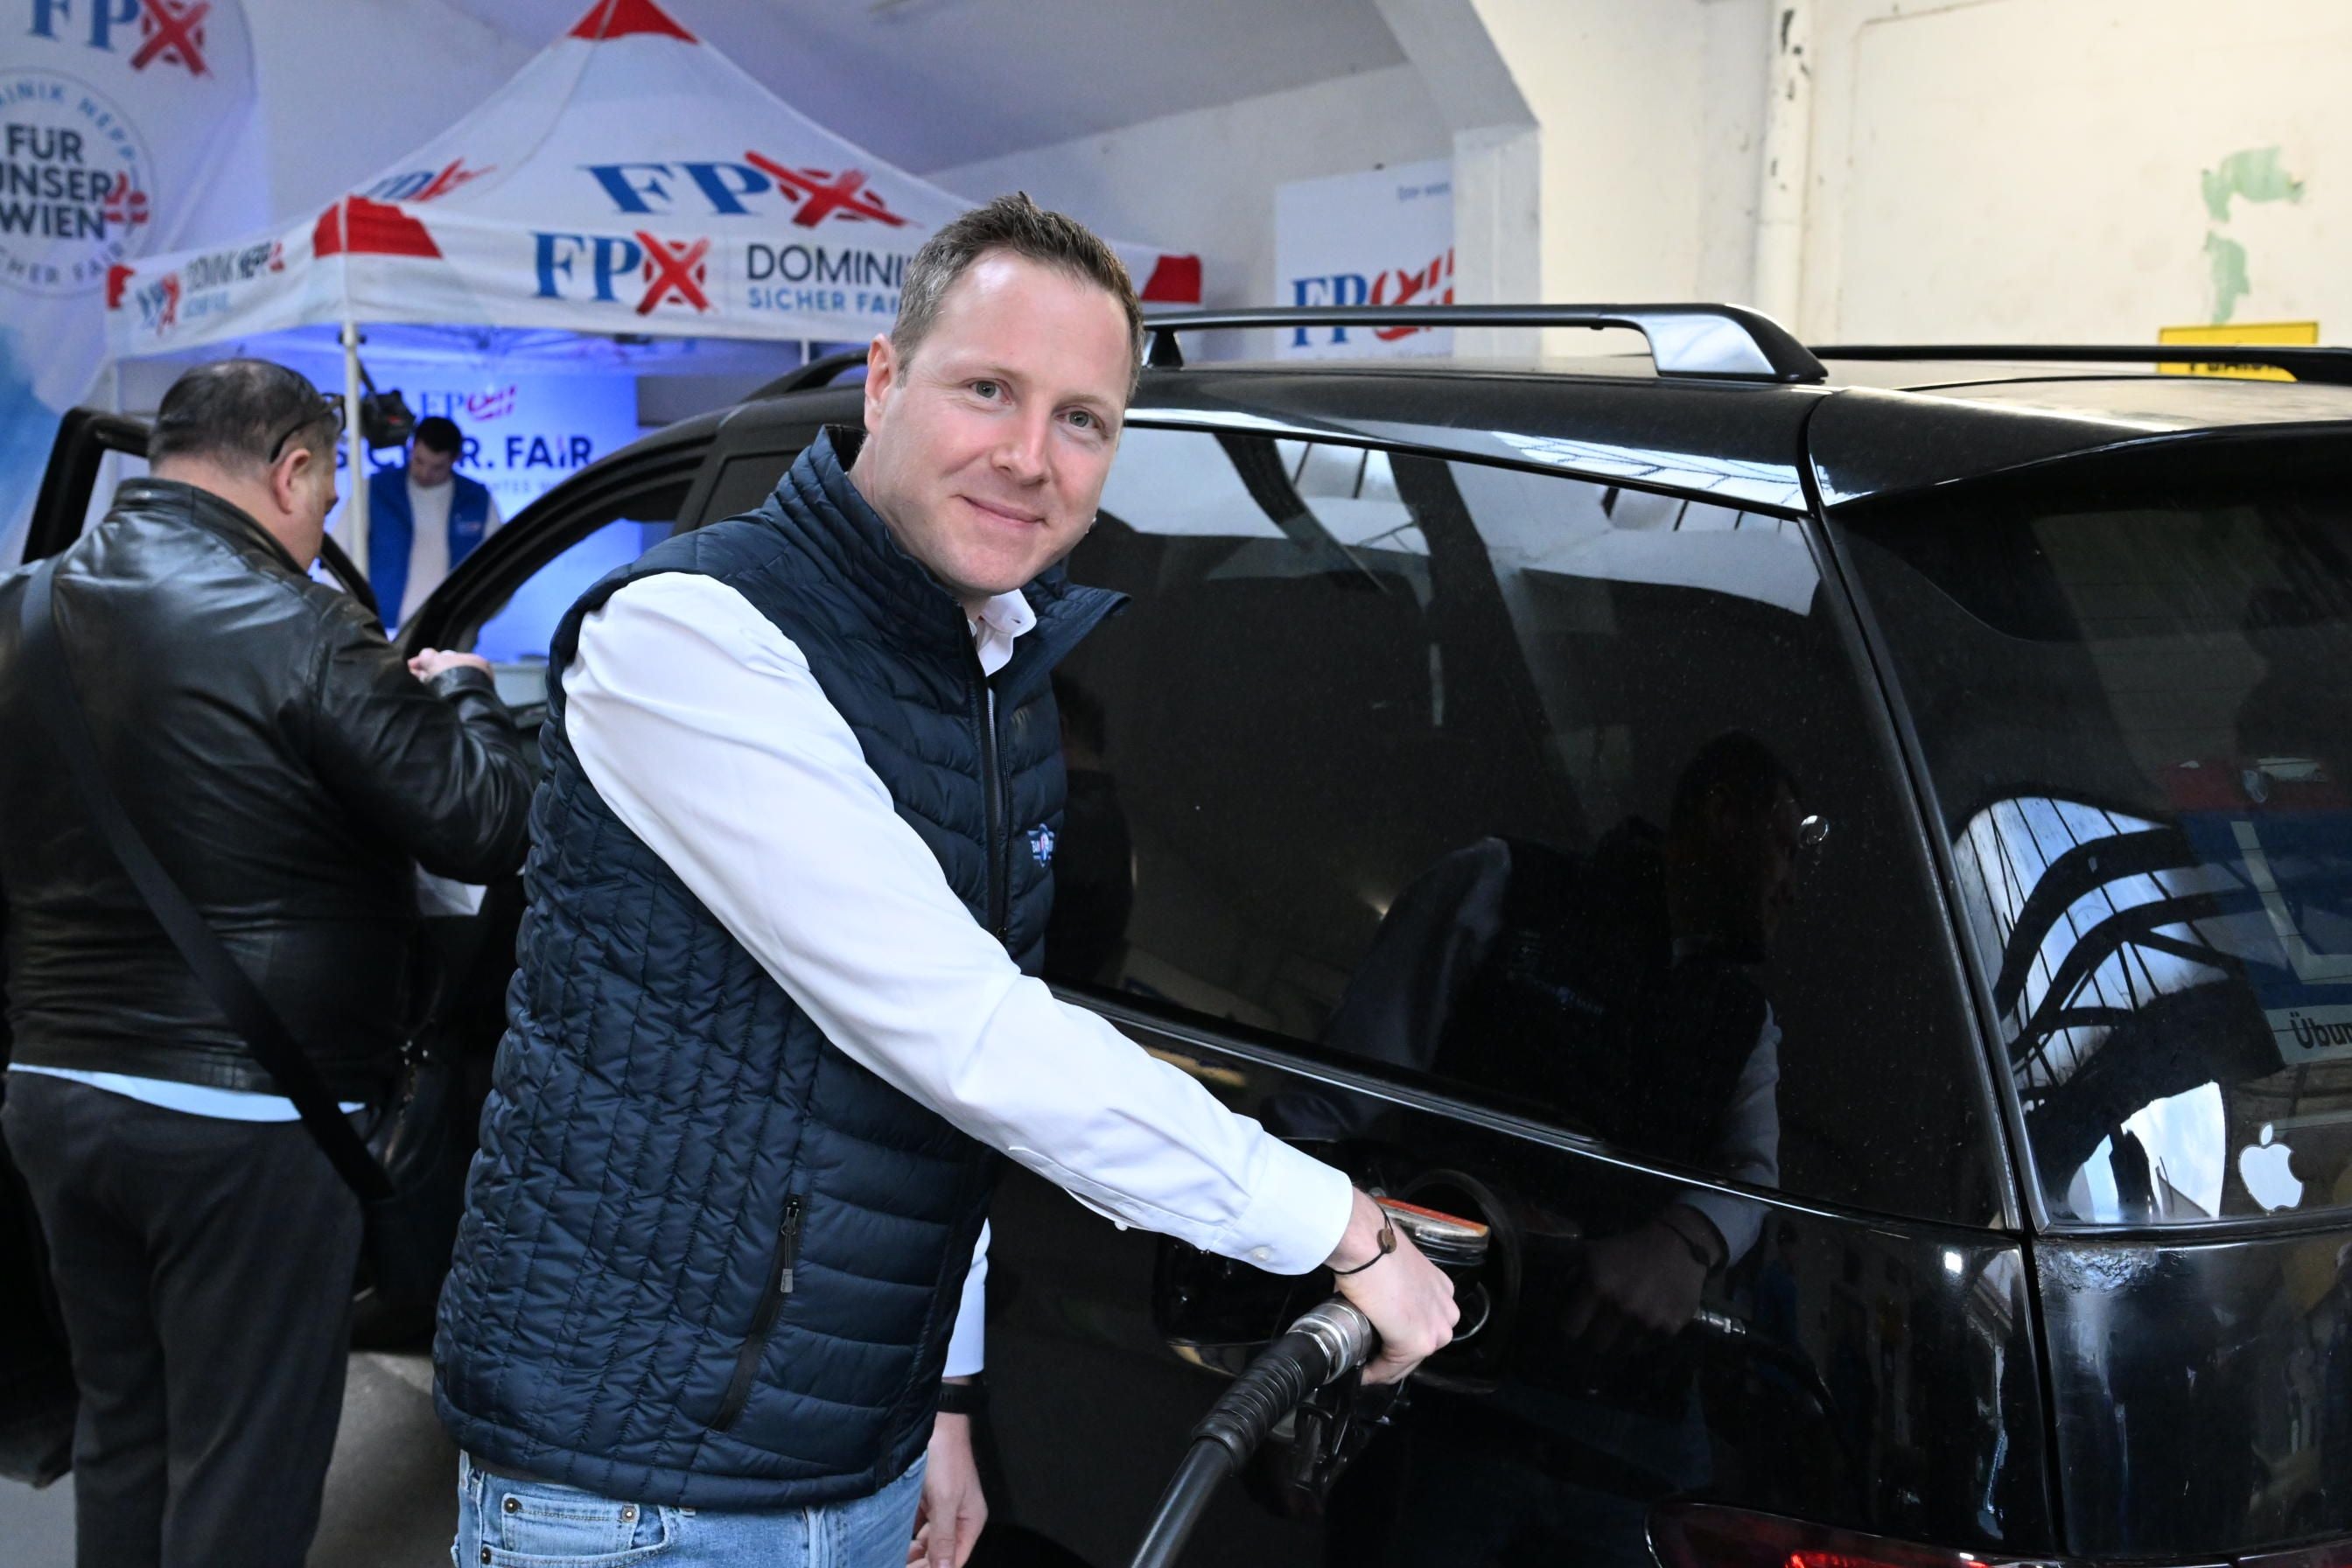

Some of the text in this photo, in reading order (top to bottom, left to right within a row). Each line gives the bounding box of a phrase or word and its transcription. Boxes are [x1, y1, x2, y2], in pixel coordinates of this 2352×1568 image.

[0, 162, 112, 202] NSER
[747, 243, 912, 288] DOMINI
[747, 287, 900, 314] SICHER FAI
